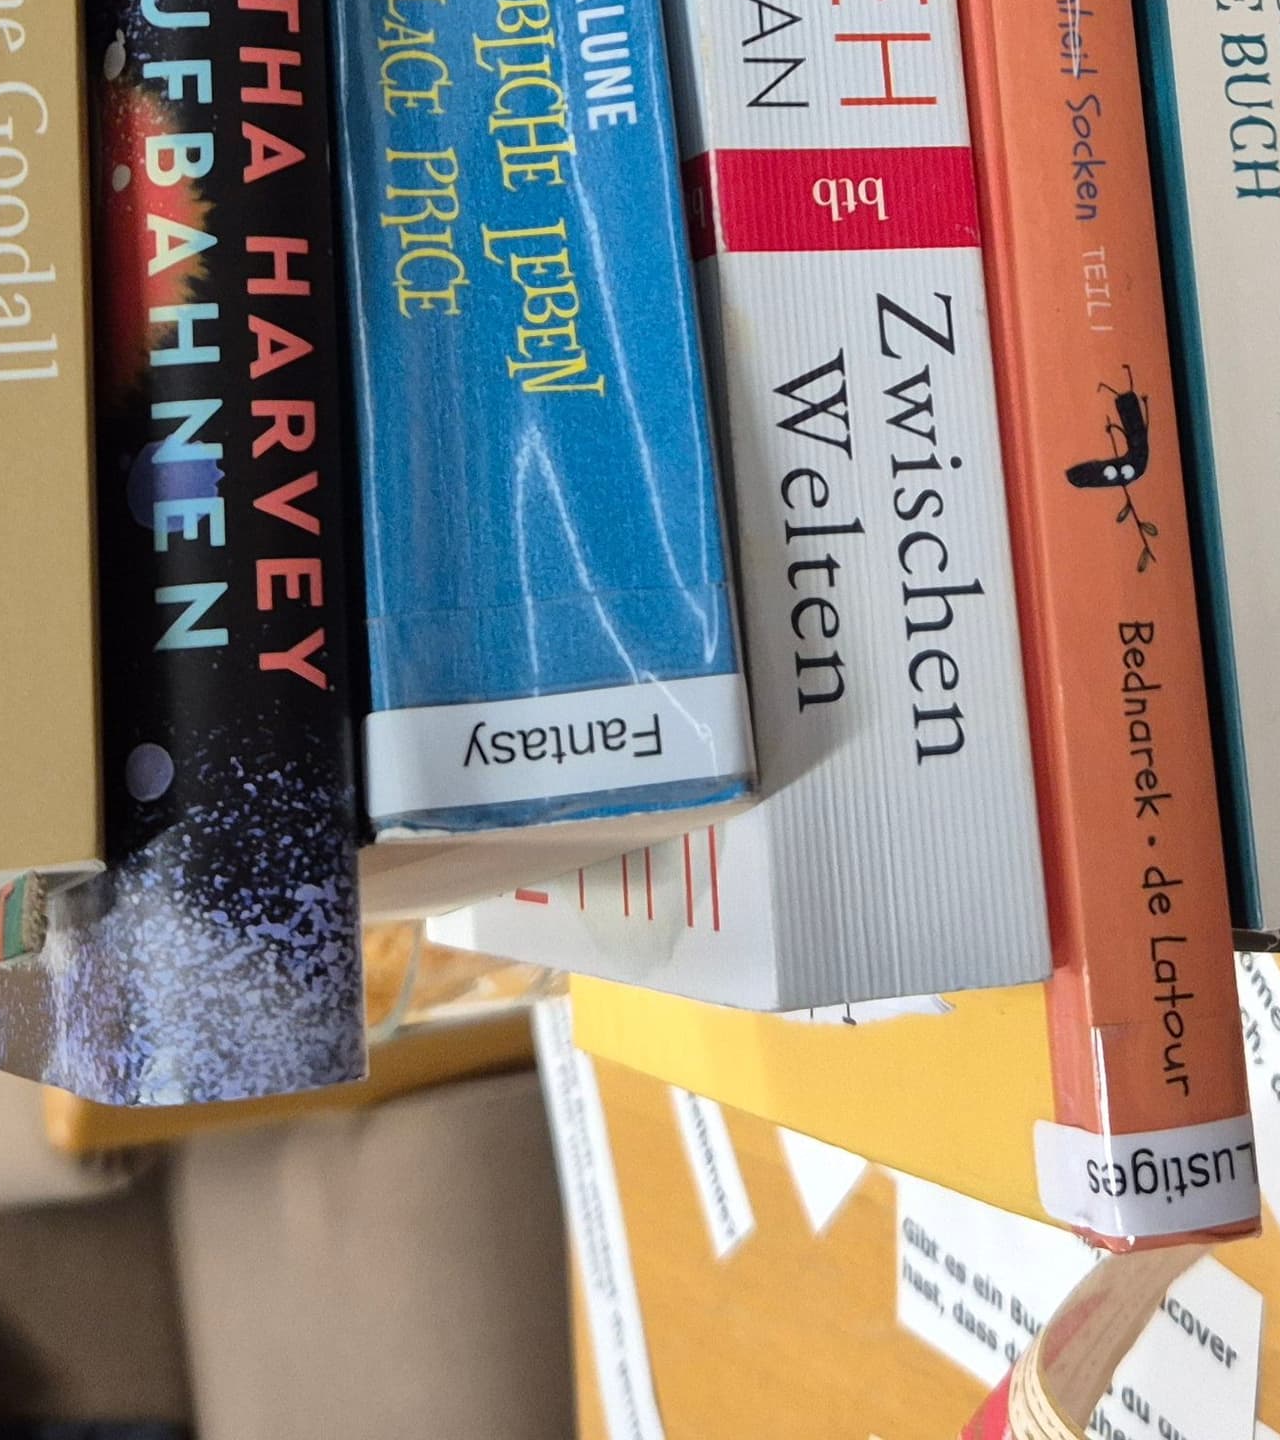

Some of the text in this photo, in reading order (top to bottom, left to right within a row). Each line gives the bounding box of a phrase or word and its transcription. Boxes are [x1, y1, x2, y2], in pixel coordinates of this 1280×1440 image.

[811, 176, 889, 223] btb
[1064, 93, 1102, 222] Socken
[378, 148, 466, 318] PRICE
[1081, 245, 1112, 316] TEIL
[480, 218, 605, 398] LEBEN
[245, 235, 327, 691] HARVEY
[771, 346, 866, 714] Welten
[874, 292, 985, 766] Zwischen
[462, 713, 664, 769] Fantasy
[1116, 619, 1163, 820] Bednarek
[1140, 864, 1184, 917] de
[1149, 934, 1194, 1099] Latour
[1085, 1141, 1259, 1205] Lustiges
[943, 1251, 968, 1286] es
[972, 1269, 1004, 1314] ein
[951, 1300, 1000, 1353] dass
